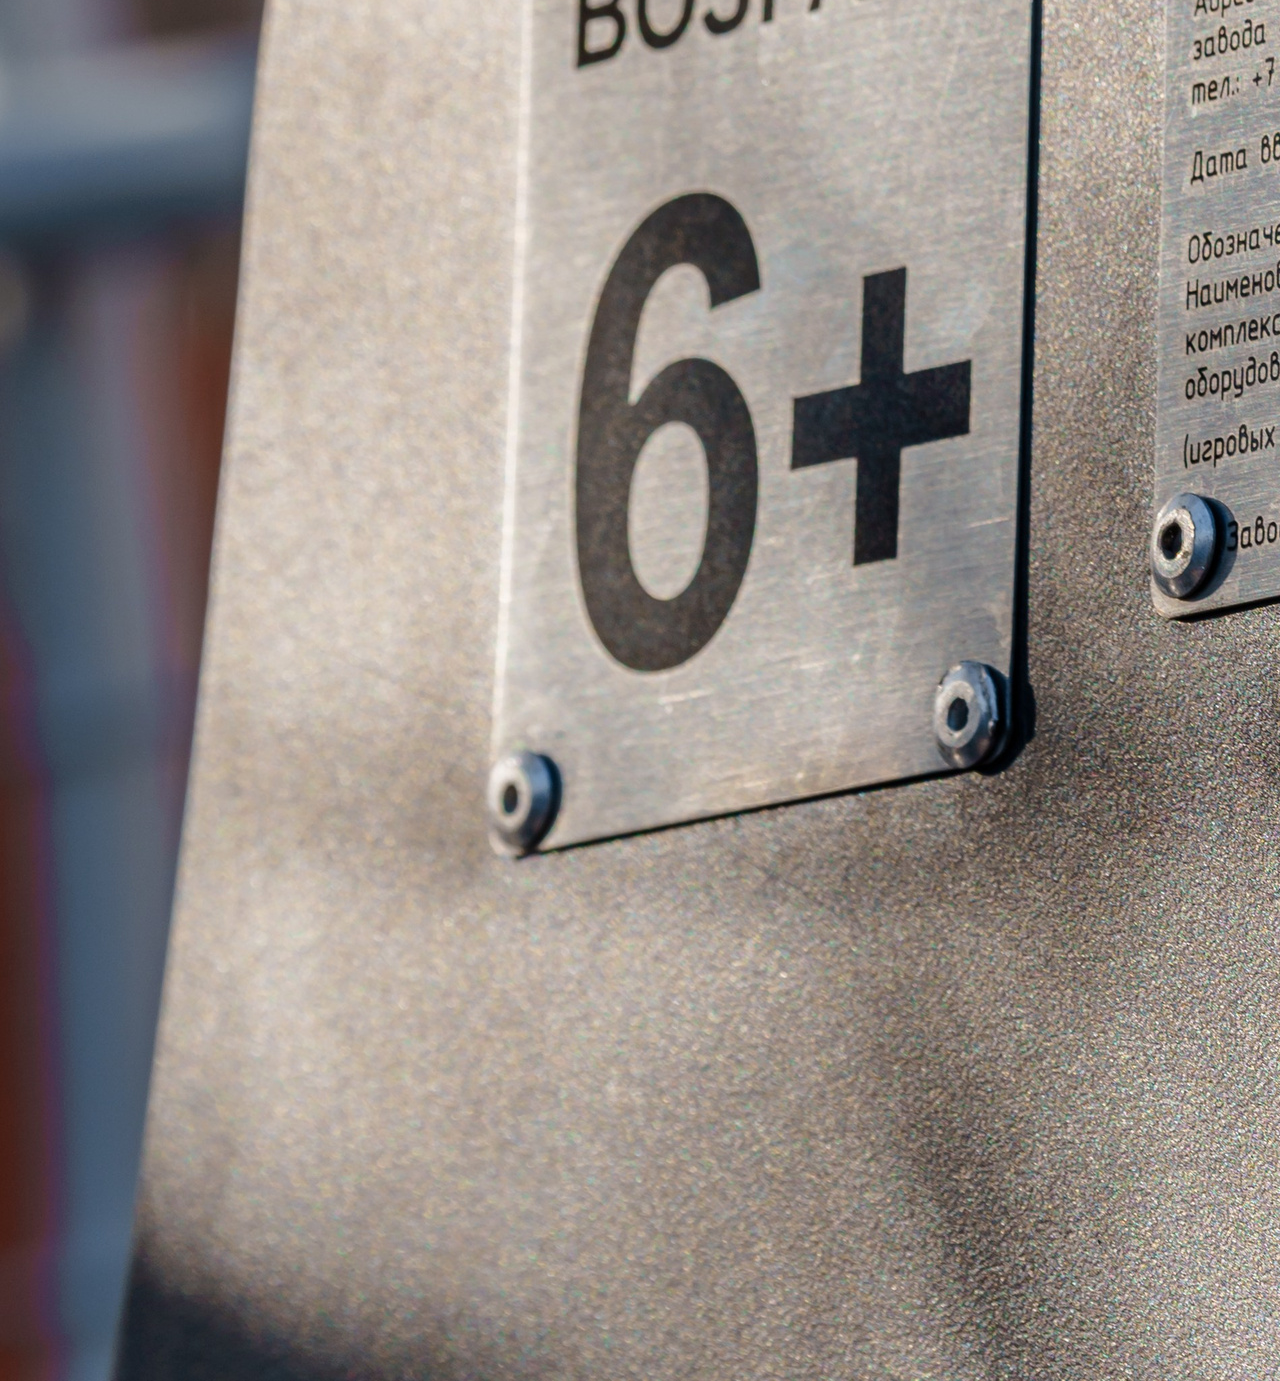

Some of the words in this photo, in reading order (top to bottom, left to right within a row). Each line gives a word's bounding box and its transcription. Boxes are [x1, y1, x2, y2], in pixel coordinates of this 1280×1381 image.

[1193, 22, 1266, 61] завода
[1191, 76, 1240, 106] тел.:
[1252, 56, 1276, 89] +7
[1190, 146, 1248, 185] Дата
[573, 190, 973, 674] 6+
[1183, 424, 1276, 468] (игровых
